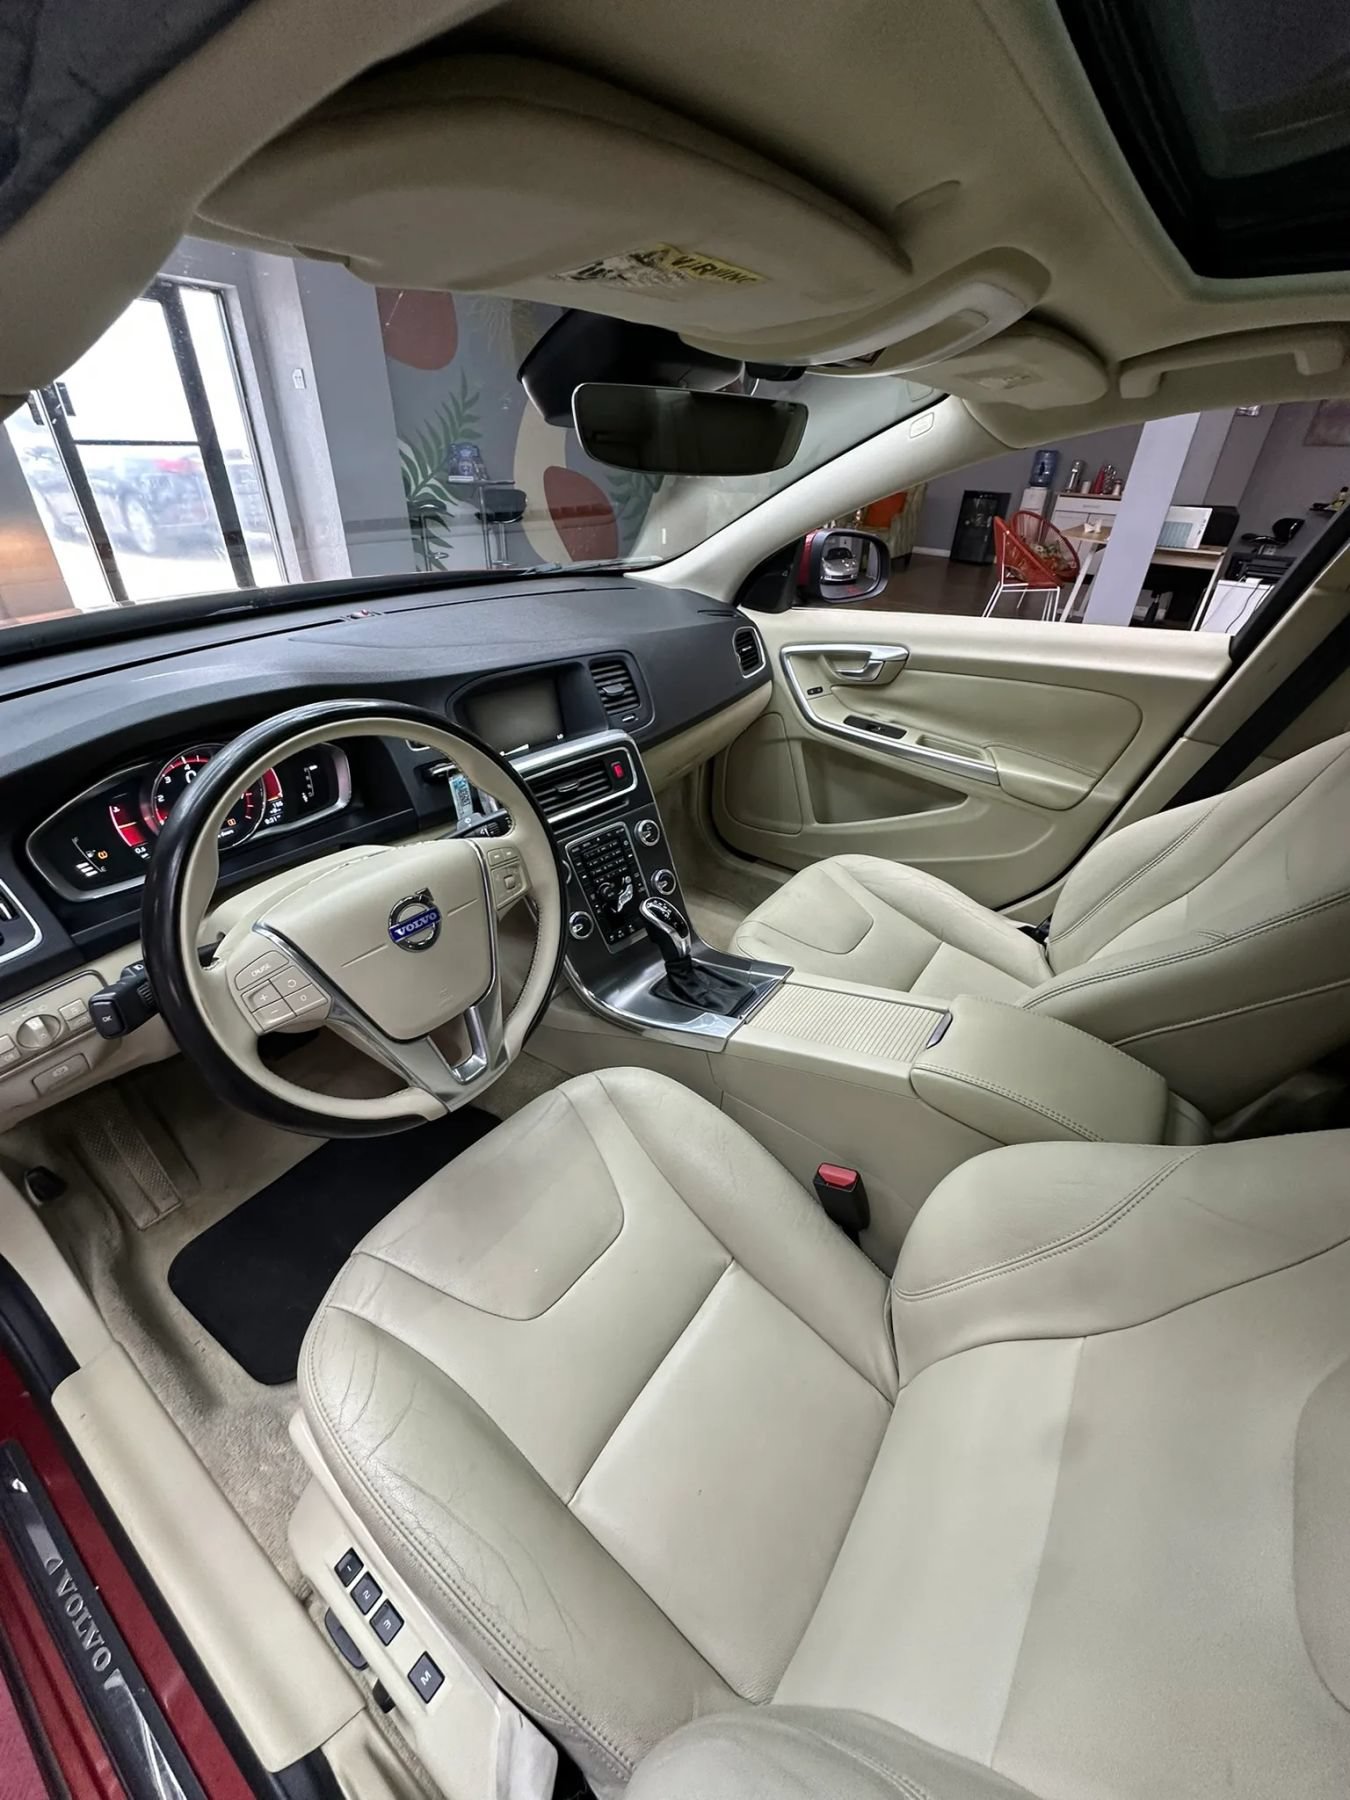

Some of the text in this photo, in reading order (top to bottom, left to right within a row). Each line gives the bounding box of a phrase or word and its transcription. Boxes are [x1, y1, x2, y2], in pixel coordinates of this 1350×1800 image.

[157, 794, 165, 802] 2
[394, 912, 438, 936] VOLVO
[362, 1589, 371, 1600] 2
[56, 1568, 112, 1672] VOLVO
[383, 1619, 392, 1630] 3
[420, 1669, 432, 1686] M
